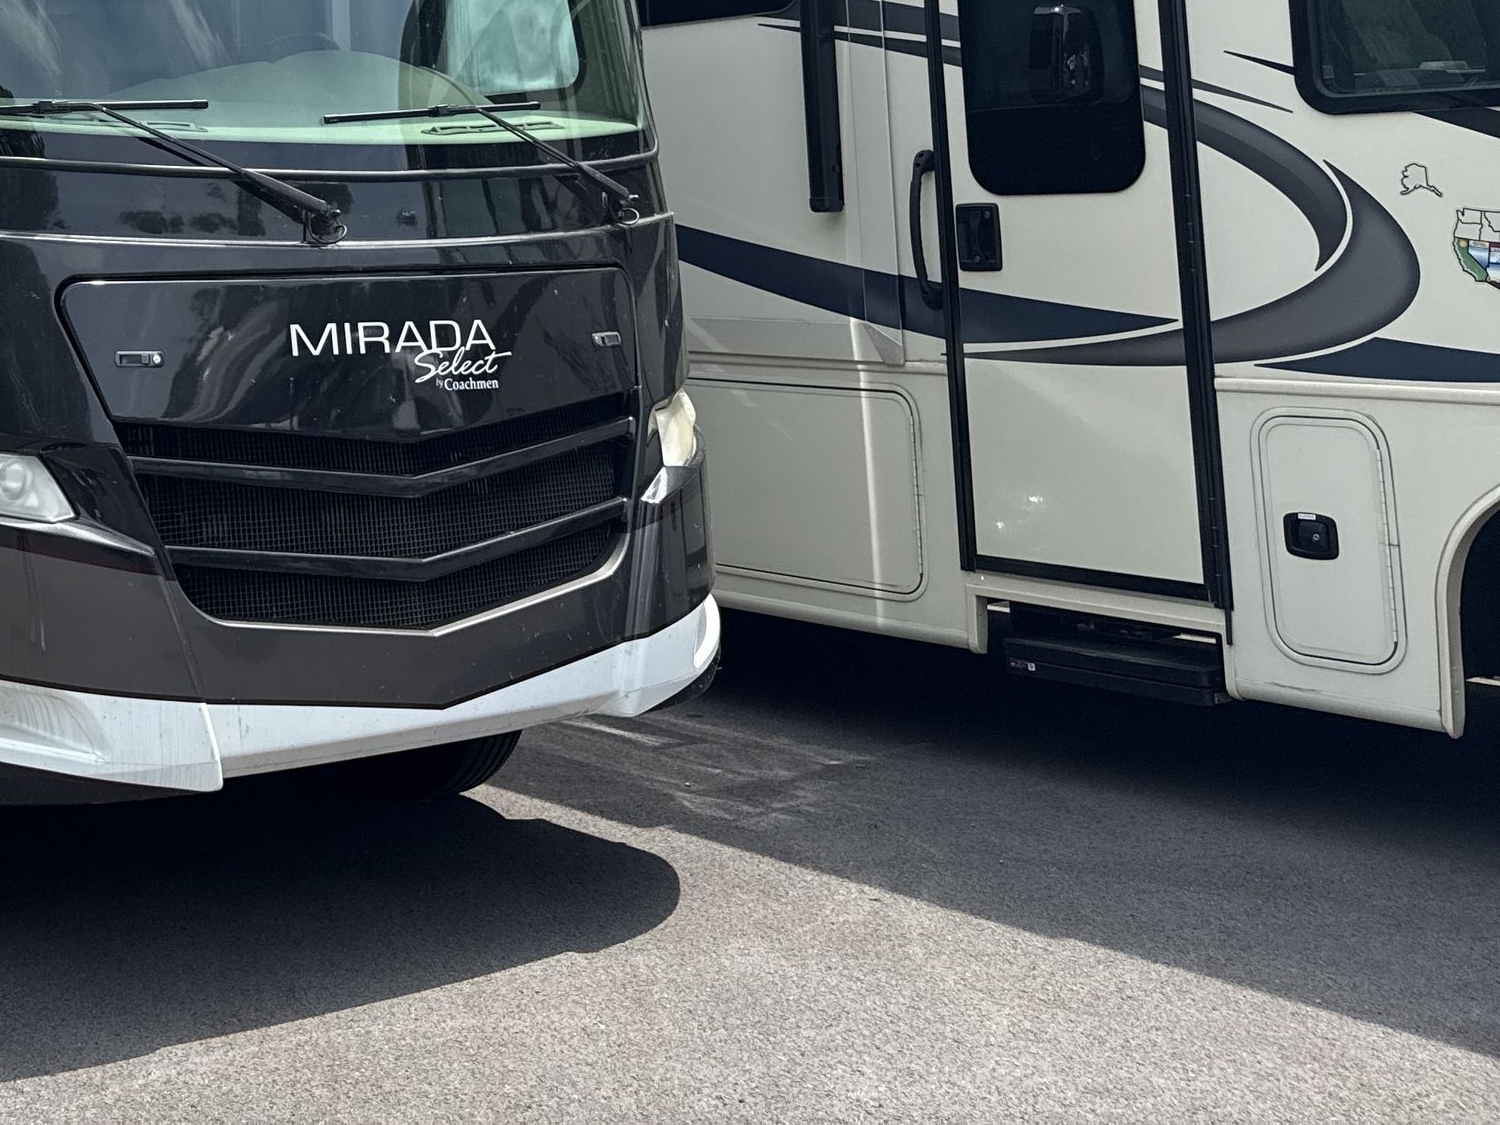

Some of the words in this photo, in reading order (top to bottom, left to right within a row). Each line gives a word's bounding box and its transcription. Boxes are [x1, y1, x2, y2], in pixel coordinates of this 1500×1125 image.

[289, 319, 496, 356] MIRADA
[414, 346, 512, 383] Select
[436, 377, 444, 389] by
[444, 377, 499, 391] Coachmen
